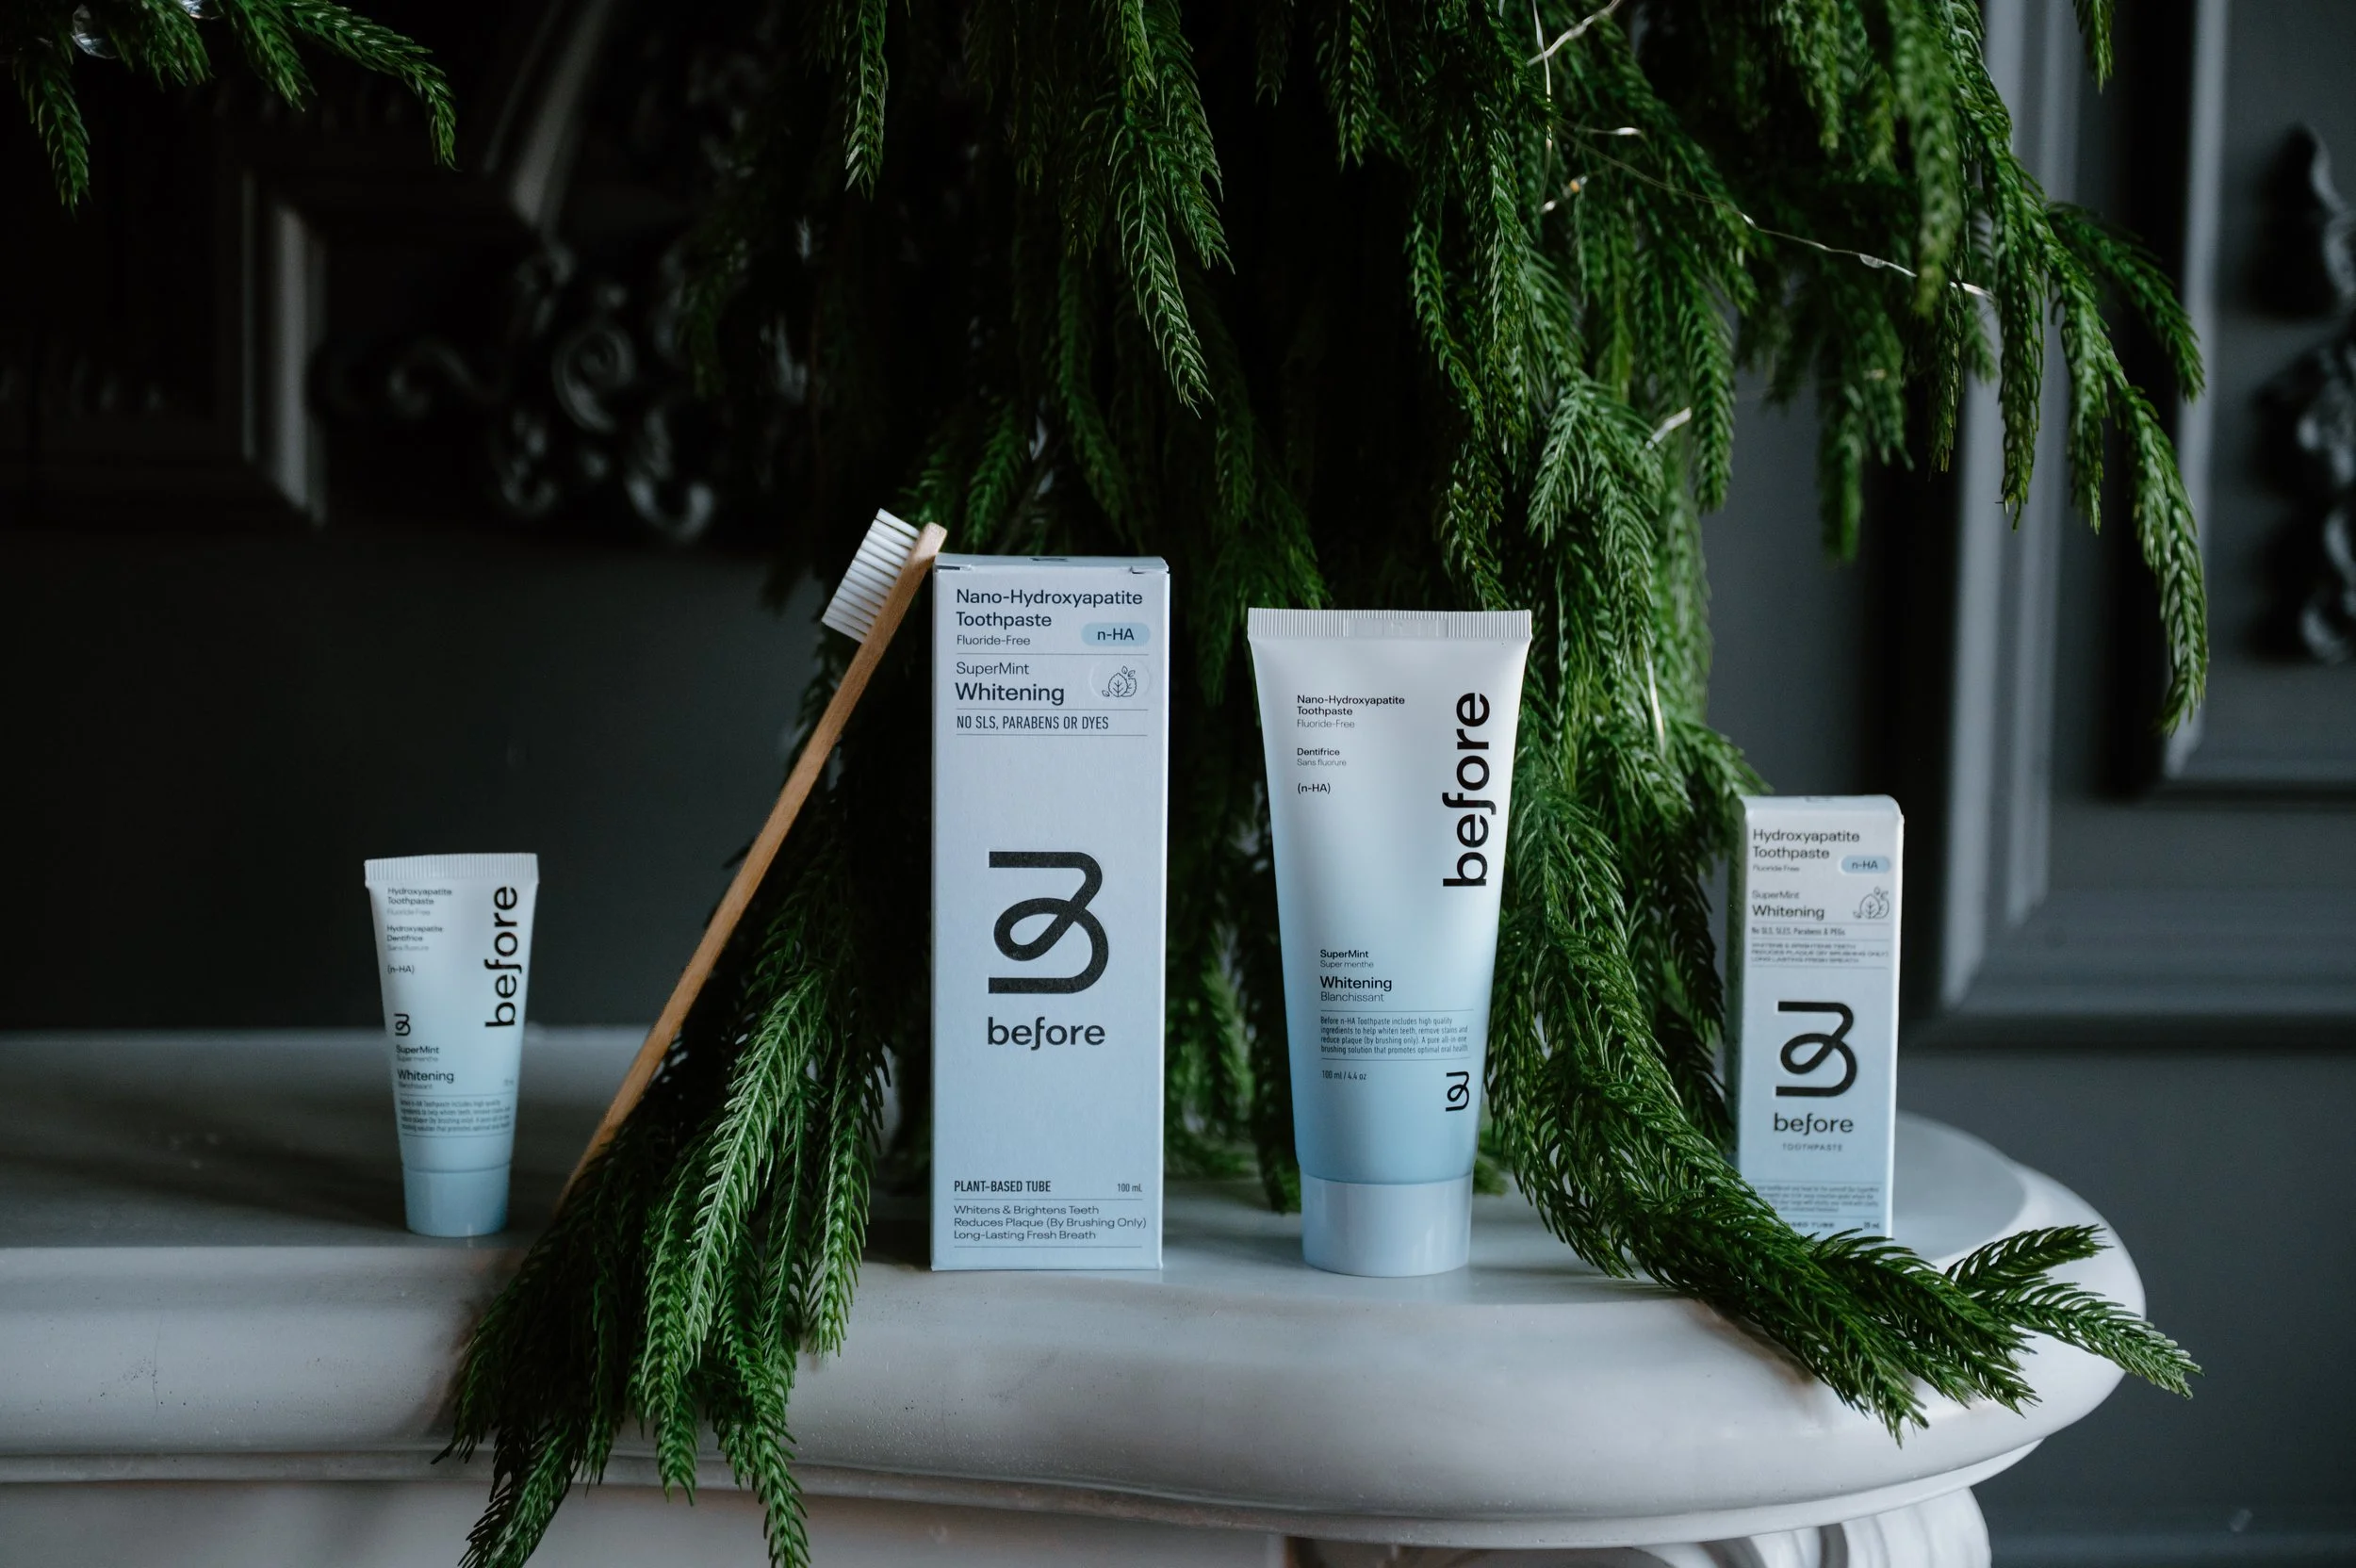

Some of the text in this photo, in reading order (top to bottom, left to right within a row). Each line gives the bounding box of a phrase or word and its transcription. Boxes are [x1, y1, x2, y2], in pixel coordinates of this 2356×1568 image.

[957, 589, 1143, 608] Nano-Hydroxyapatite
[956, 612, 1052, 629] Toothpaste
[957, 635, 1031, 645] Fluoride-Free
[1097, 629, 1135, 641] n-HA
[956, 662, 1029, 678] SuperMint
[955, 683, 1065, 706] Whitening
[1297, 694, 1405, 707] Nano-Hydroxyapatite
[1297, 706, 1353, 717] Toothpaste
[957, 715, 1108, 730] NO SLS, PARABENS OR DYES
[1297, 719, 1355, 728] Fluoride-Free
[1297, 747, 1340, 756] Dentifrice
[1297, 758, 1347, 767] Sans fluorure
[1297, 782, 1331, 794] (n-HA)
[1441, 693, 1497, 887] before
[1753, 828, 1860, 844] Hydroxyapatite
[1753, 846, 1830, 860] Toothpaste
[1851, 860, 1878, 870] n-HA
[387, 887, 452, 896] Hydroxyapatite
[1752, 890, 1799, 901] SuperMint
[387, 897, 434, 906] Toothpaste
[1752, 905, 1825, 921] Whitening
[483, 886, 522, 1028] before
[1319, 949, 1369, 960] SuperMint
[386, 964, 415, 975] (n-HA)
[1319, 960, 1342, 970] Super
[1319, 975, 1393, 992] Whitening
[1320, 991, 1384, 1003] Blanchissant
[1320, 1017, 1339, 1025] Before
[1357, 1018, 1391, 1026] Toothpaste
[1418, 1018, 1432, 1026] high
[988, 1016, 1105, 1051] before
[1341, 1037, 1363, 1045] plaque
[1364, 1037, 1374, 1045] (by
[1375, 1037, 1402, 1046] brushing
[396, 1044, 440, 1055] SuperMint
[1320, 1045, 1347, 1054] brushing
[1387, 1047, 1416, 1055] promotes
[396, 1068, 454, 1085] Whitening
[1321, 1070, 1333, 1079] 100
[1773, 1112, 1854, 1135] before
[1782, 1143, 1843, 1152] TOOTHPASTE
[954, 1180, 1051, 1193] PLANT-BASED TUBE
[1117, 1184, 1130, 1192] 100
[954, 1205, 1099, 1217] Whitens & Brightens Teeth
[954, 1217, 1147, 1229] Reduces Plaque (By Brushing Only)
[954, 1231, 1096, 1241] Long-Lasting Fresh Breath
